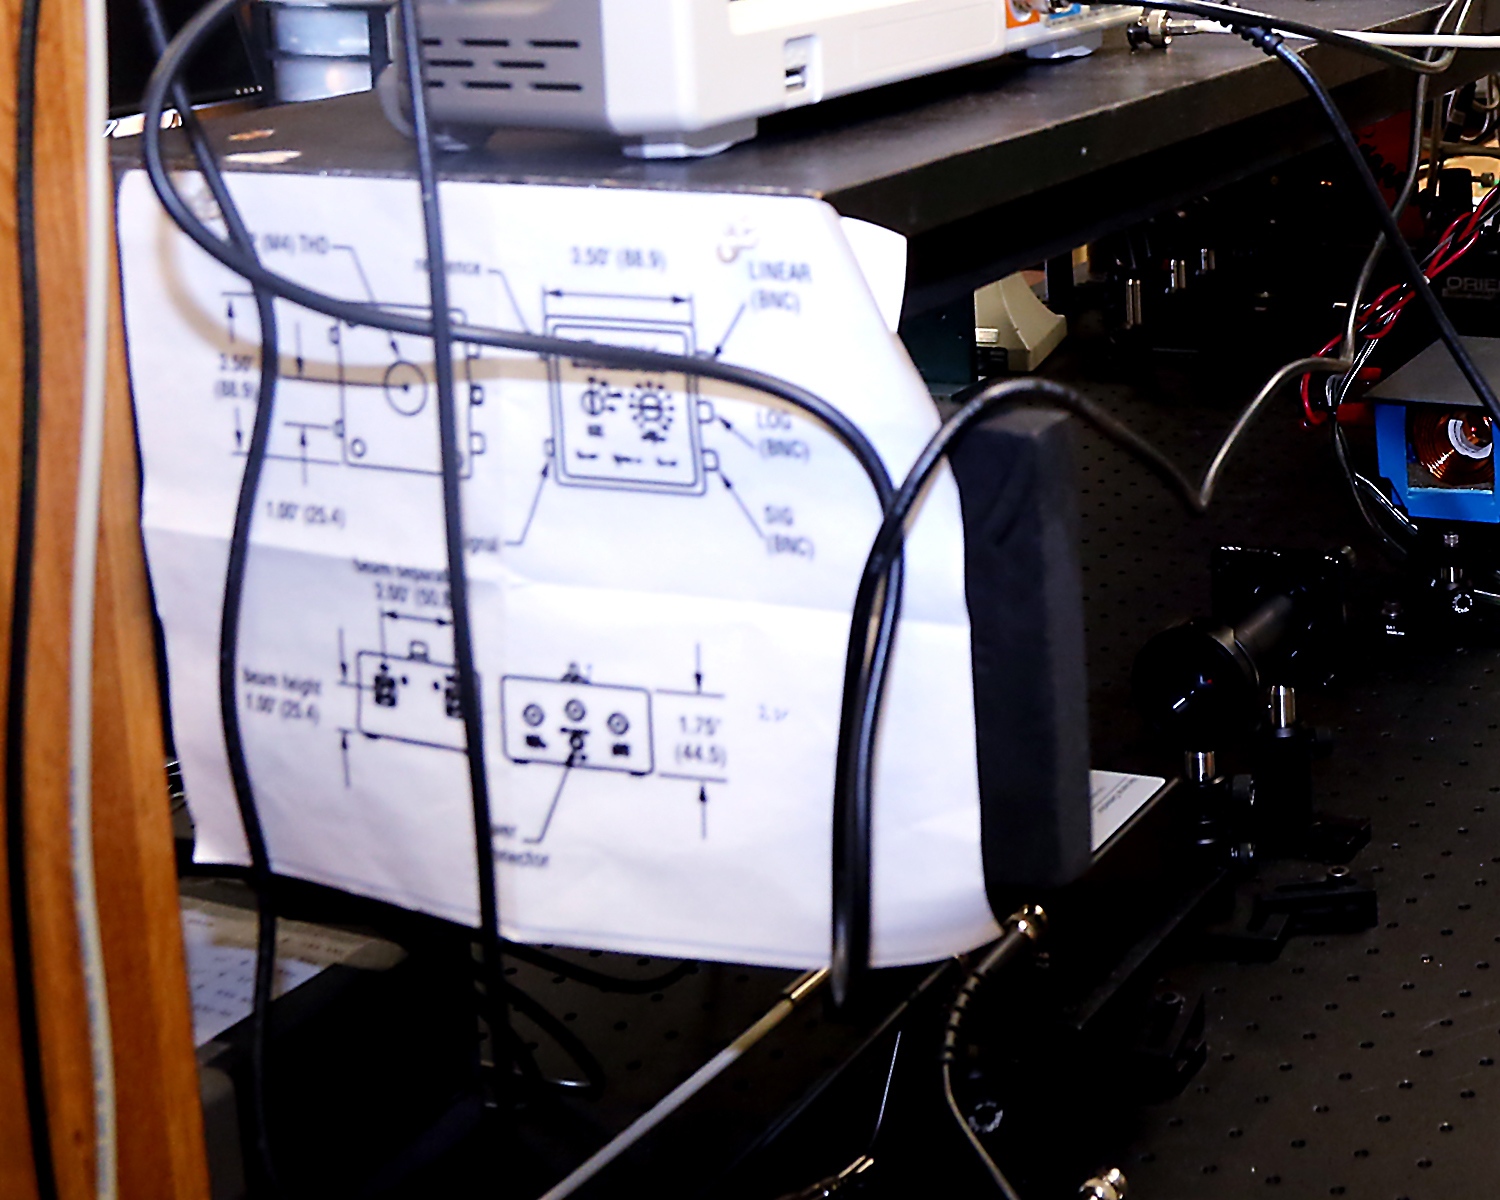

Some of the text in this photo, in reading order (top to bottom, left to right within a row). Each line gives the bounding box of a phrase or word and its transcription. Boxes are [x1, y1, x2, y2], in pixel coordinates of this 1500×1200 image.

[747, 260, 812, 284] LINEAR
[752, 288, 802, 316] (BNC)
[757, 408, 792, 432] LOG
[761, 437, 811, 463] (BNC)
[765, 505, 794, 527] SIG
[766, 532, 816, 560] (BNC)
[352, 557, 392, 577] beam
[242, 666, 322, 698] beam height
[674, 742, 728, 770] (44.5)
